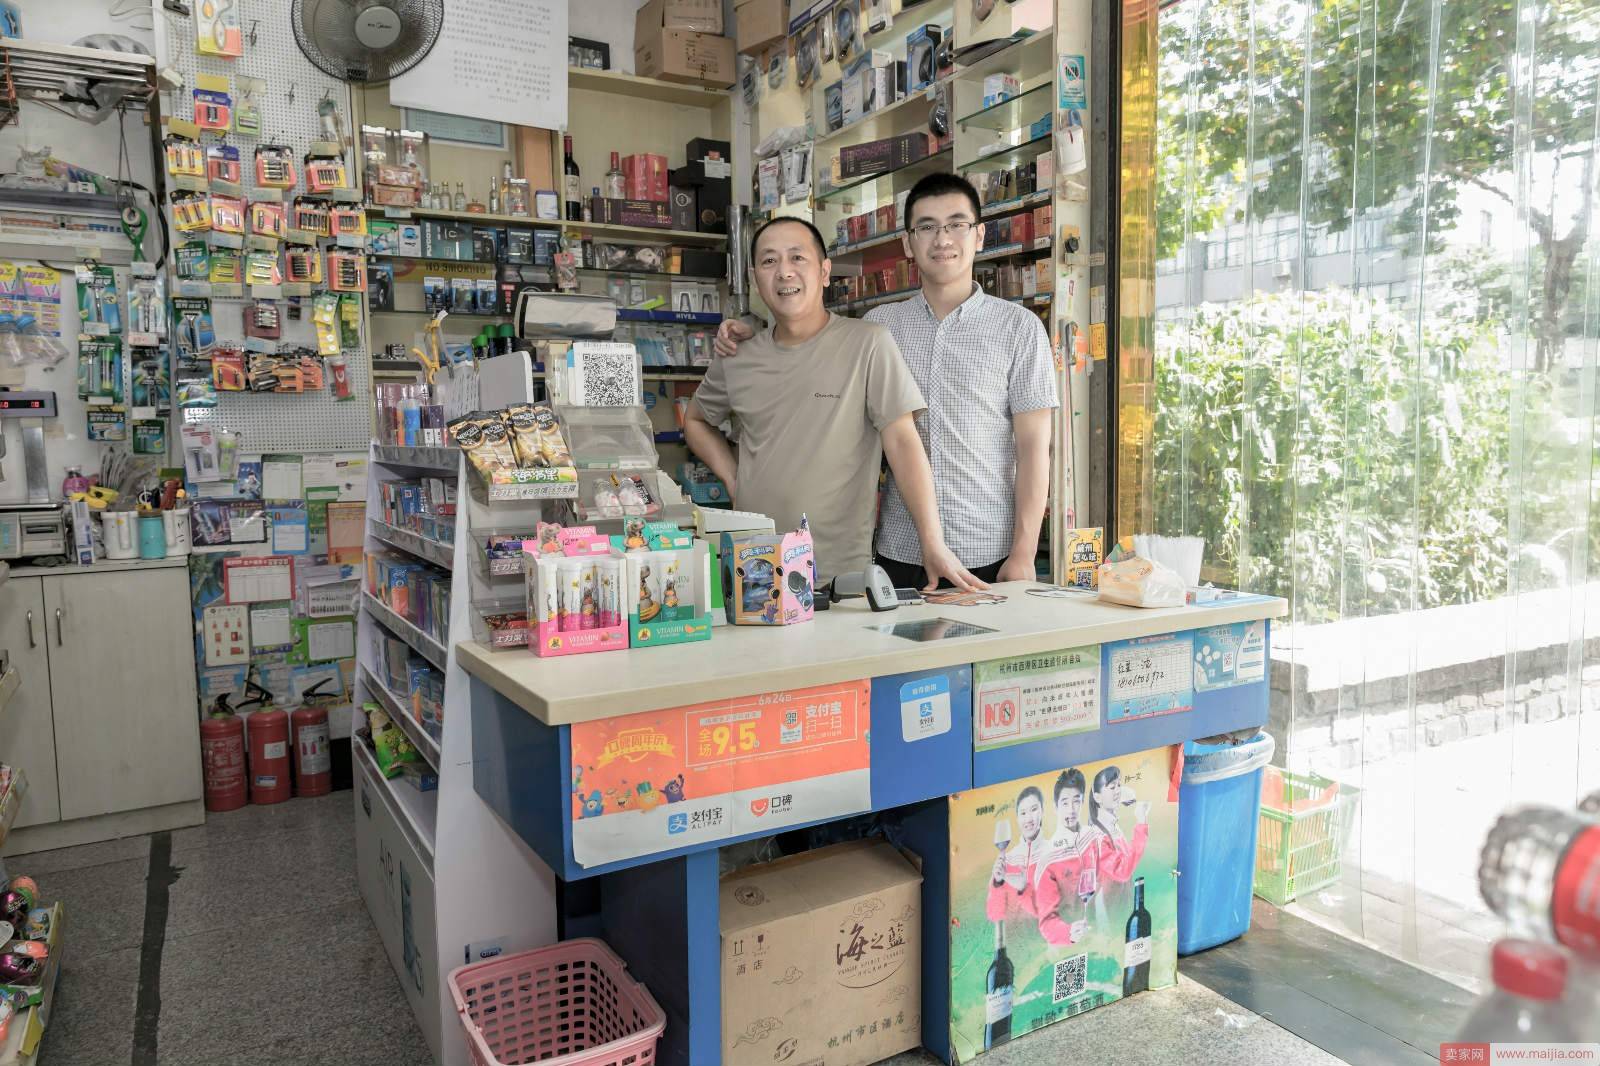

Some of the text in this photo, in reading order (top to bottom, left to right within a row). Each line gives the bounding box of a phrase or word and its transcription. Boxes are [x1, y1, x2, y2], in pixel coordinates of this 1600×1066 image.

[649, 523, 679, 531] VITAMIN
[1077, 543, 1092, 553] 杭州
[1073, 552, 1097, 562] 怎么玩
[656, 626, 684, 634] VITAMIN
[569, 632, 599, 641] VITAMIN
[805, 701, 842, 718] 支付宝
[984, 699, 1016, 728] NO
[712, 722, 757, 756] 9.5
[771, 794, 793, 808] 口碑
[691, 807, 723, 823] 支付宝
